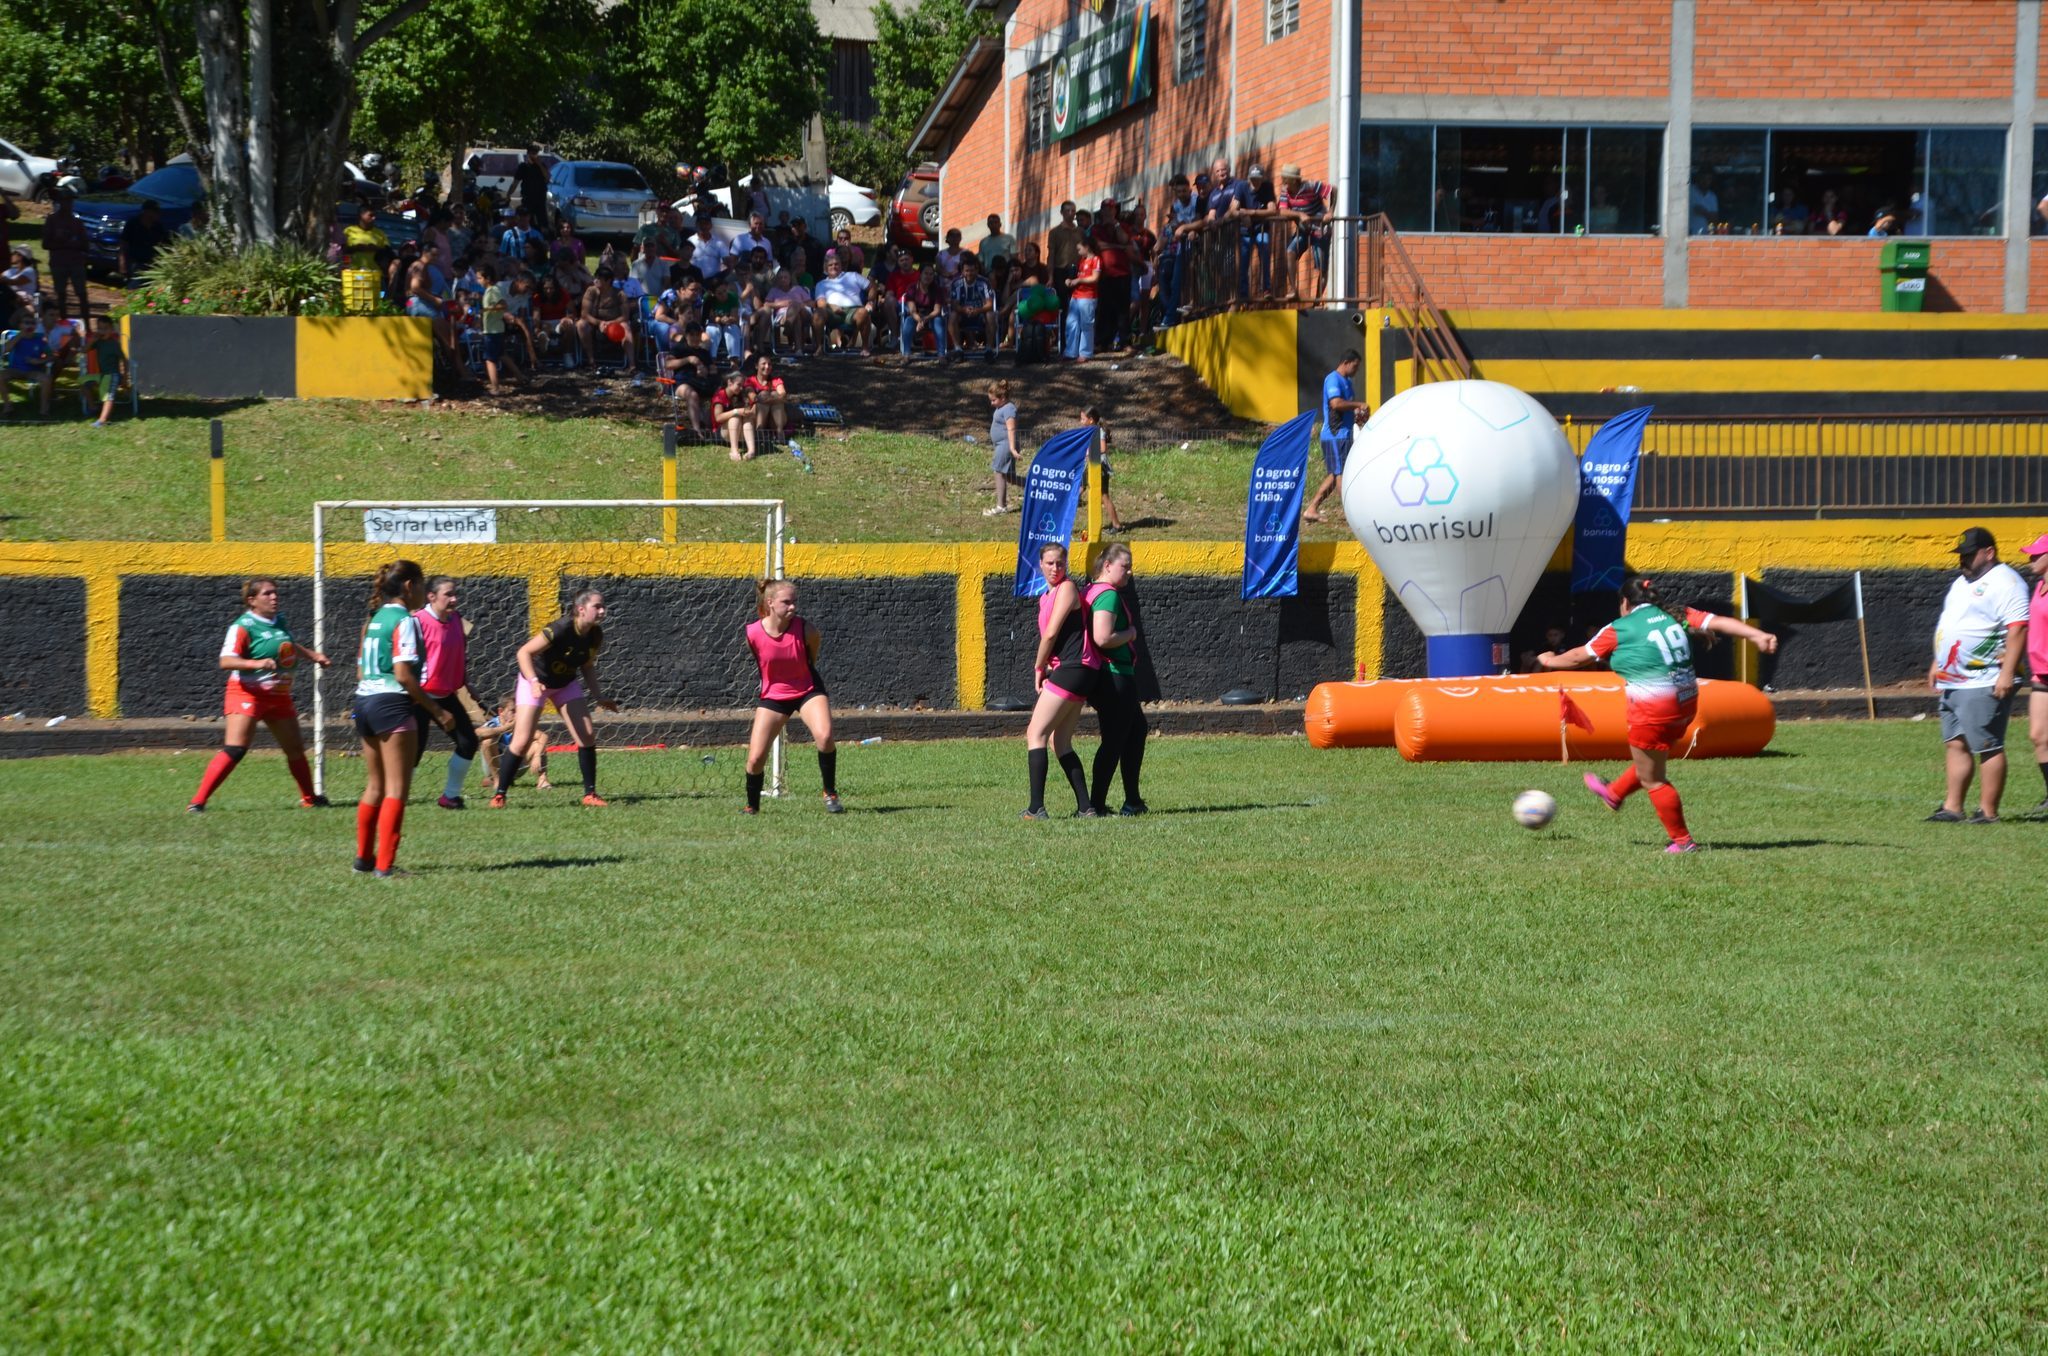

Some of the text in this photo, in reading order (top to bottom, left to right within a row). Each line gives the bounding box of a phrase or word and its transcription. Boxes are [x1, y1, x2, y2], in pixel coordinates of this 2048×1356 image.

[1032, 463, 1075, 480] O agro é
[1255, 466, 1300, 480] O agro é
[1583, 461, 1631, 475] O agro é
[1031, 479, 1072, 491] o nosso
[1255, 481, 1296, 490] o nosso
[1584, 475, 1627, 485] o nosso
[1030, 489, 1057, 502] chão.
[1254, 491, 1283, 502] chão.
[373, 516, 488, 532] Serrar Lenha
[1373, 512, 1493, 544] banrisul
[1028, 531, 1065, 543] banrisul
[1254, 533, 1289, 543] banrisu
[1583, 528, 1619, 537] banrisu
[1647, 623, 1691, 666] 19
[363, 637, 380, 675] 11
